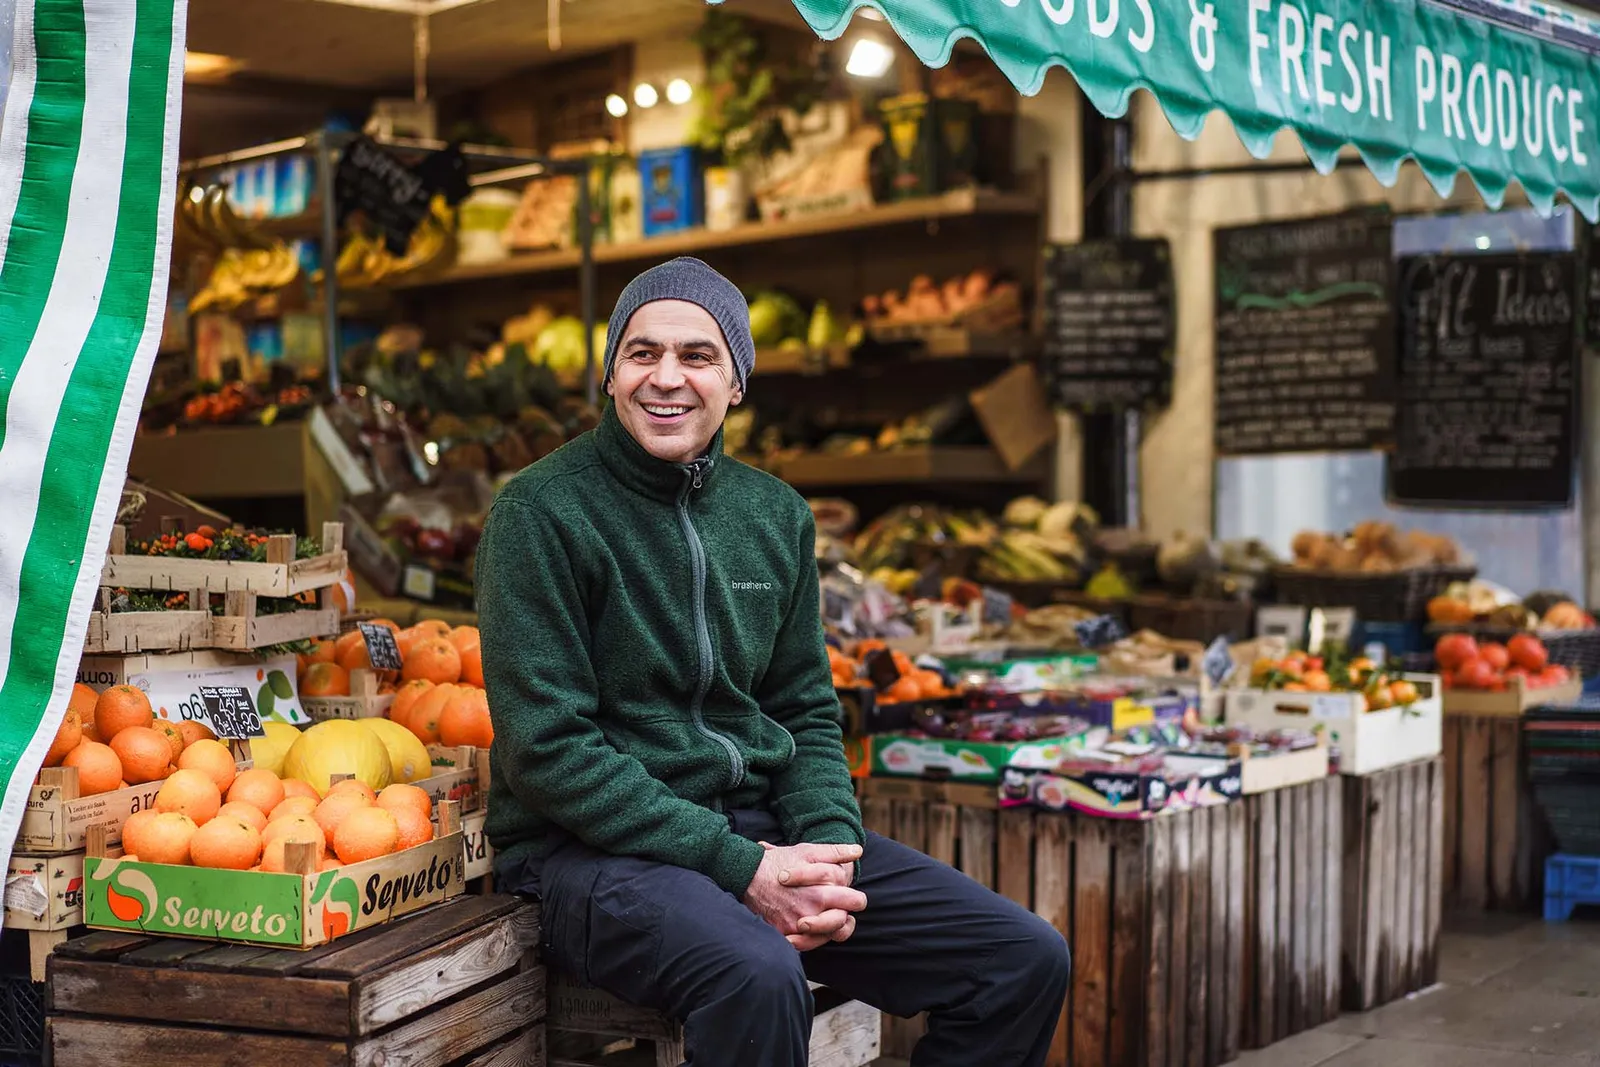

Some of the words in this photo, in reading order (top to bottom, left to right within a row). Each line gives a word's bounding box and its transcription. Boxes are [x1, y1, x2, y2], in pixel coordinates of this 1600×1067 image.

[1189, 0, 1219, 72] &
[1247, 2, 1393, 121] FRESH
[1415, 45, 1588, 166] PRODUCE
[1493, 259, 1571, 326] Ideas
[731, 580, 763, 590] brasher
[362, 855, 450, 916] Serveto
[162, 896, 287, 937] Serveto
